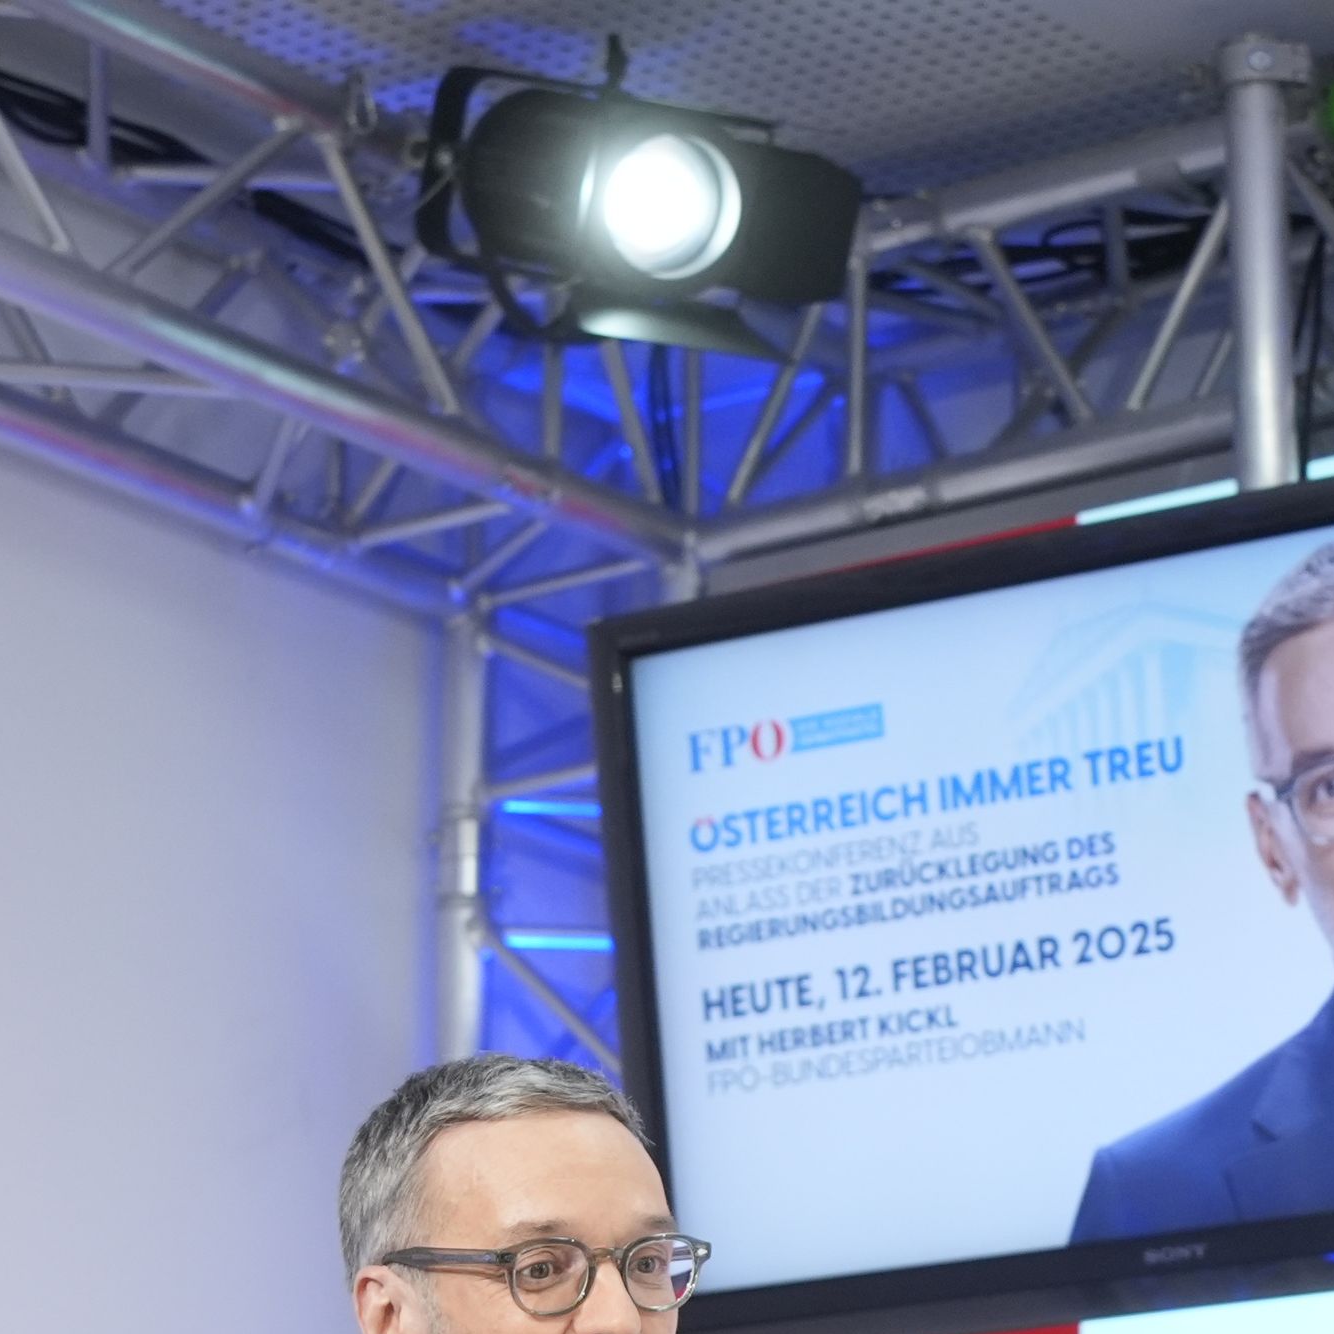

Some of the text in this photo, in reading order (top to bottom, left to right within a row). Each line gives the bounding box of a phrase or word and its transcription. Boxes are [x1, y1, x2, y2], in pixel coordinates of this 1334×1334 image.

[689, 735, 1184, 852] ÖSTERREICH IMMER TREU
[692, 822, 980, 889] PRESSEKONFERENZ AUS
[696, 831, 1116, 921] ANLASS DER ZURÜCKLEGUNG DES
[697, 862, 1120, 951] REGIERUNGSBILDUNGSAUFTRAGS
[703, 918, 1176, 1021] HEUTE, 12. FEBRUAR 2025
[706, 1004, 959, 1063] MIT HERBERT KICKL
